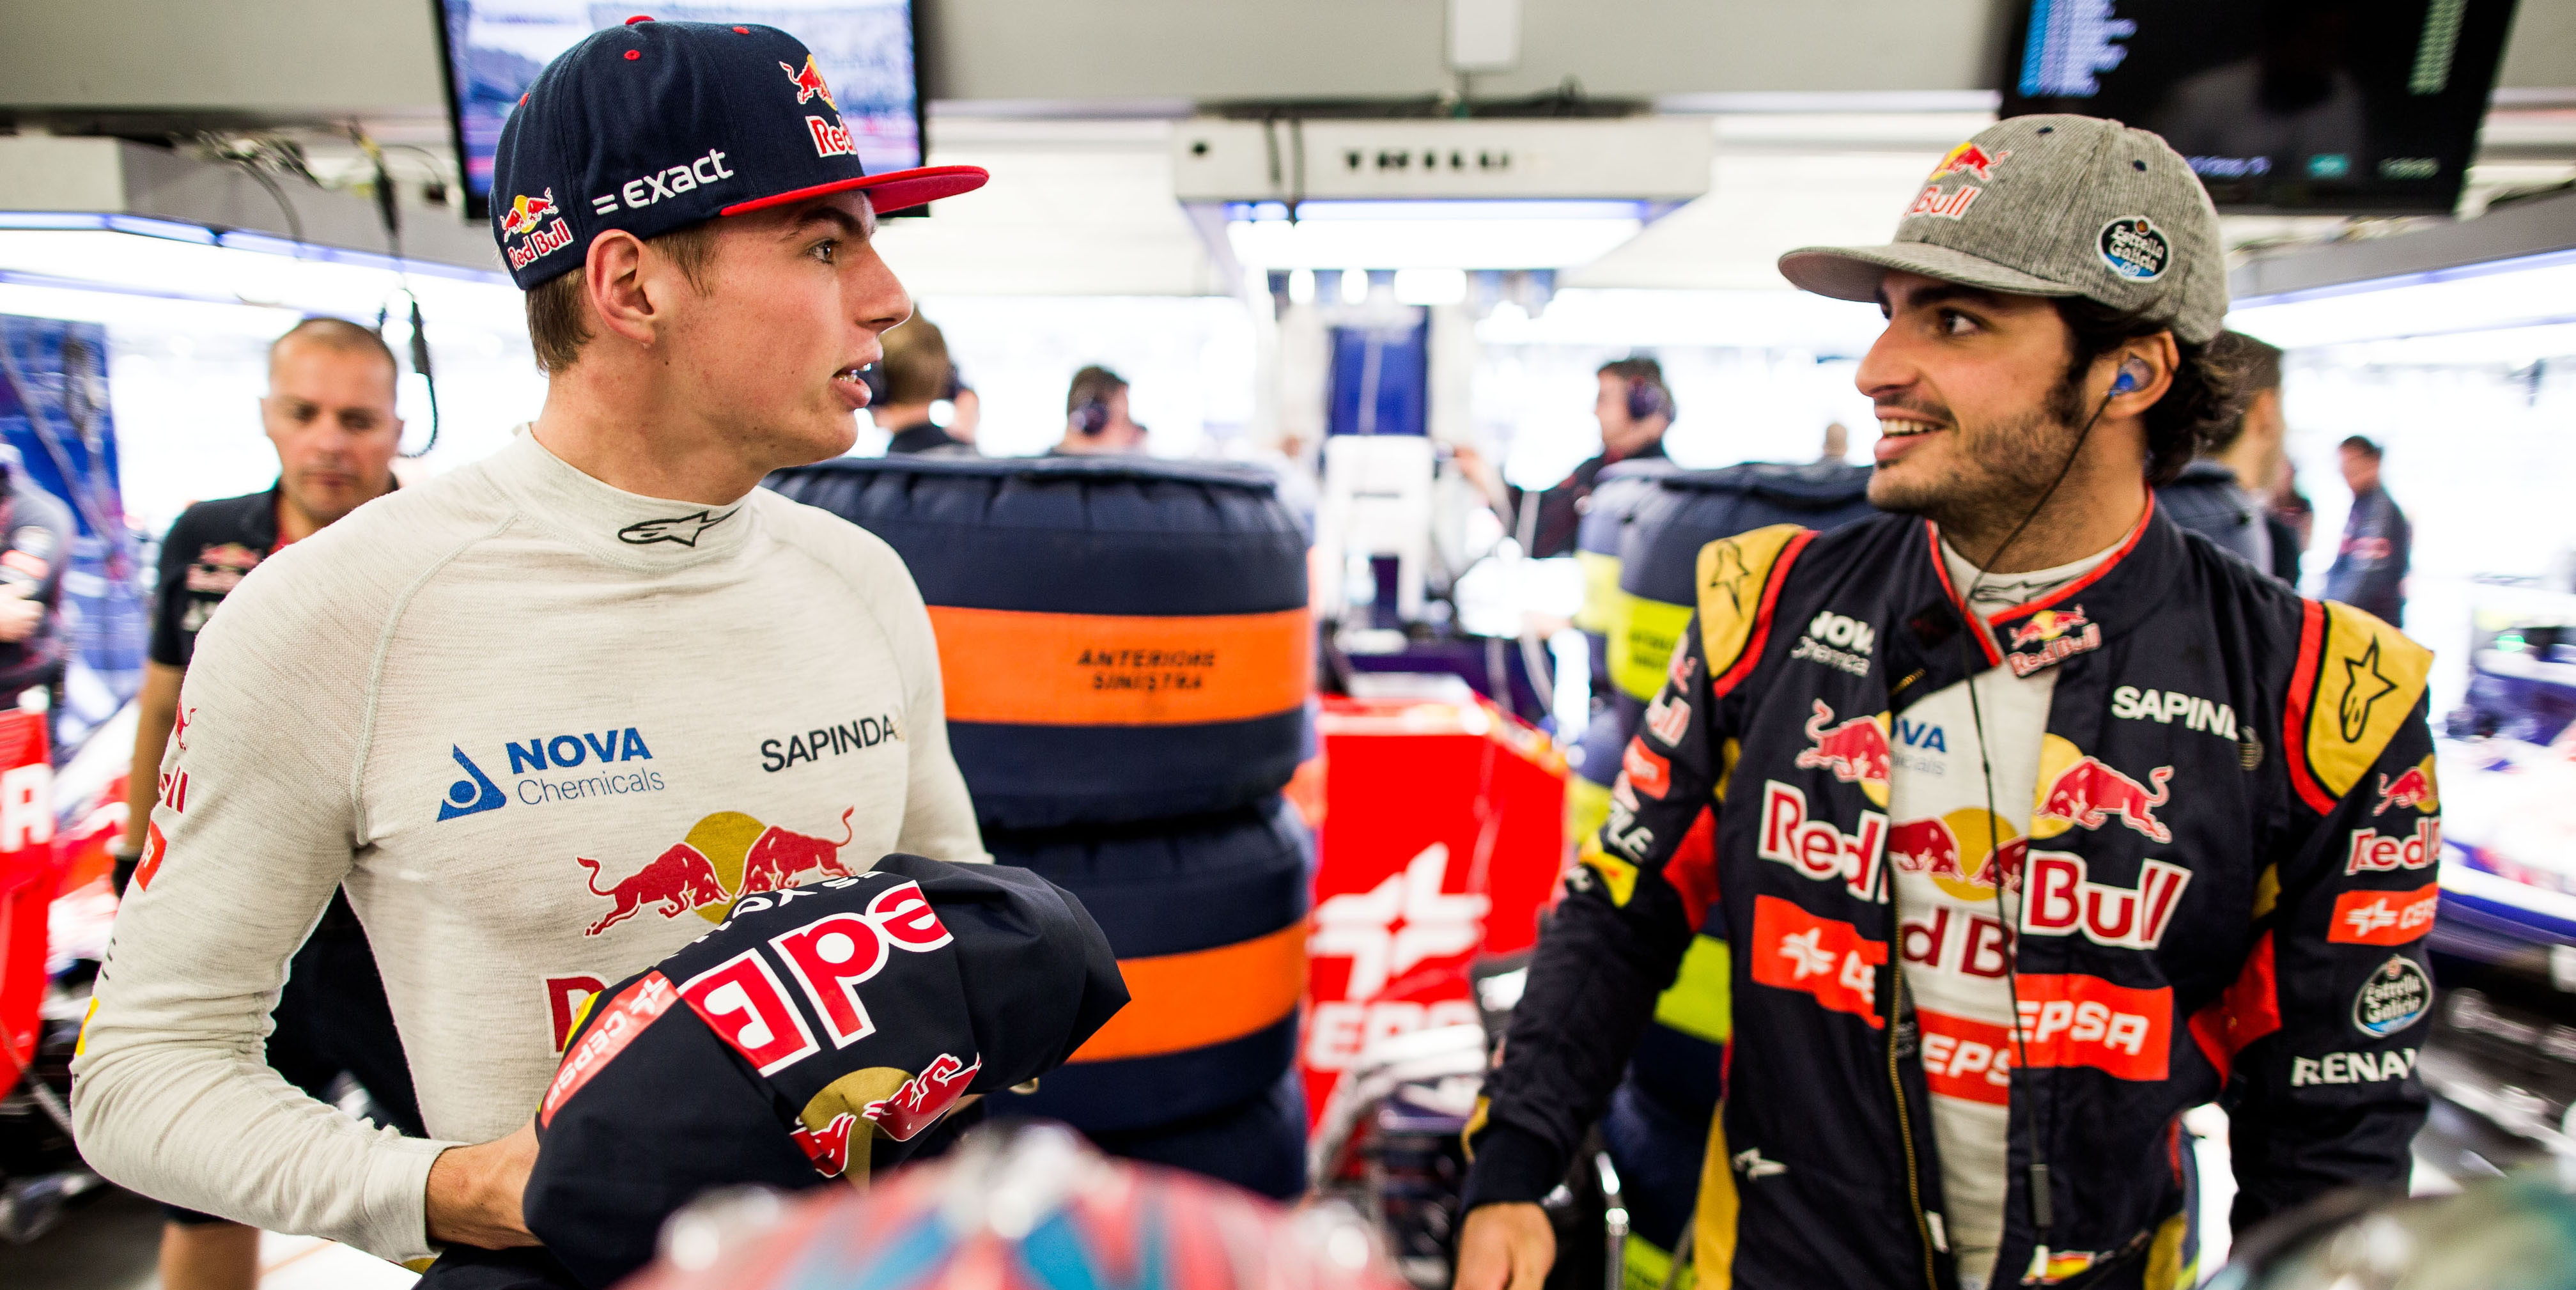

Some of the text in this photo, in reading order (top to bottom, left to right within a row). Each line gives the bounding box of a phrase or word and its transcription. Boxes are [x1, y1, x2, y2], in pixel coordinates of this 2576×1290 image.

[508, 217, 574, 270] Red Bull
[2008, 623, 2102, 679] Red Bull
[506, 727, 653, 775] NOVA
[761, 713, 898, 772] SAPINDA
[1891, 717, 1947, 753] VA
[517, 767, 665, 805] Chemicals
[1757, 779, 1889, 902] Red
[2020, 848, 2192, 951] Bull
